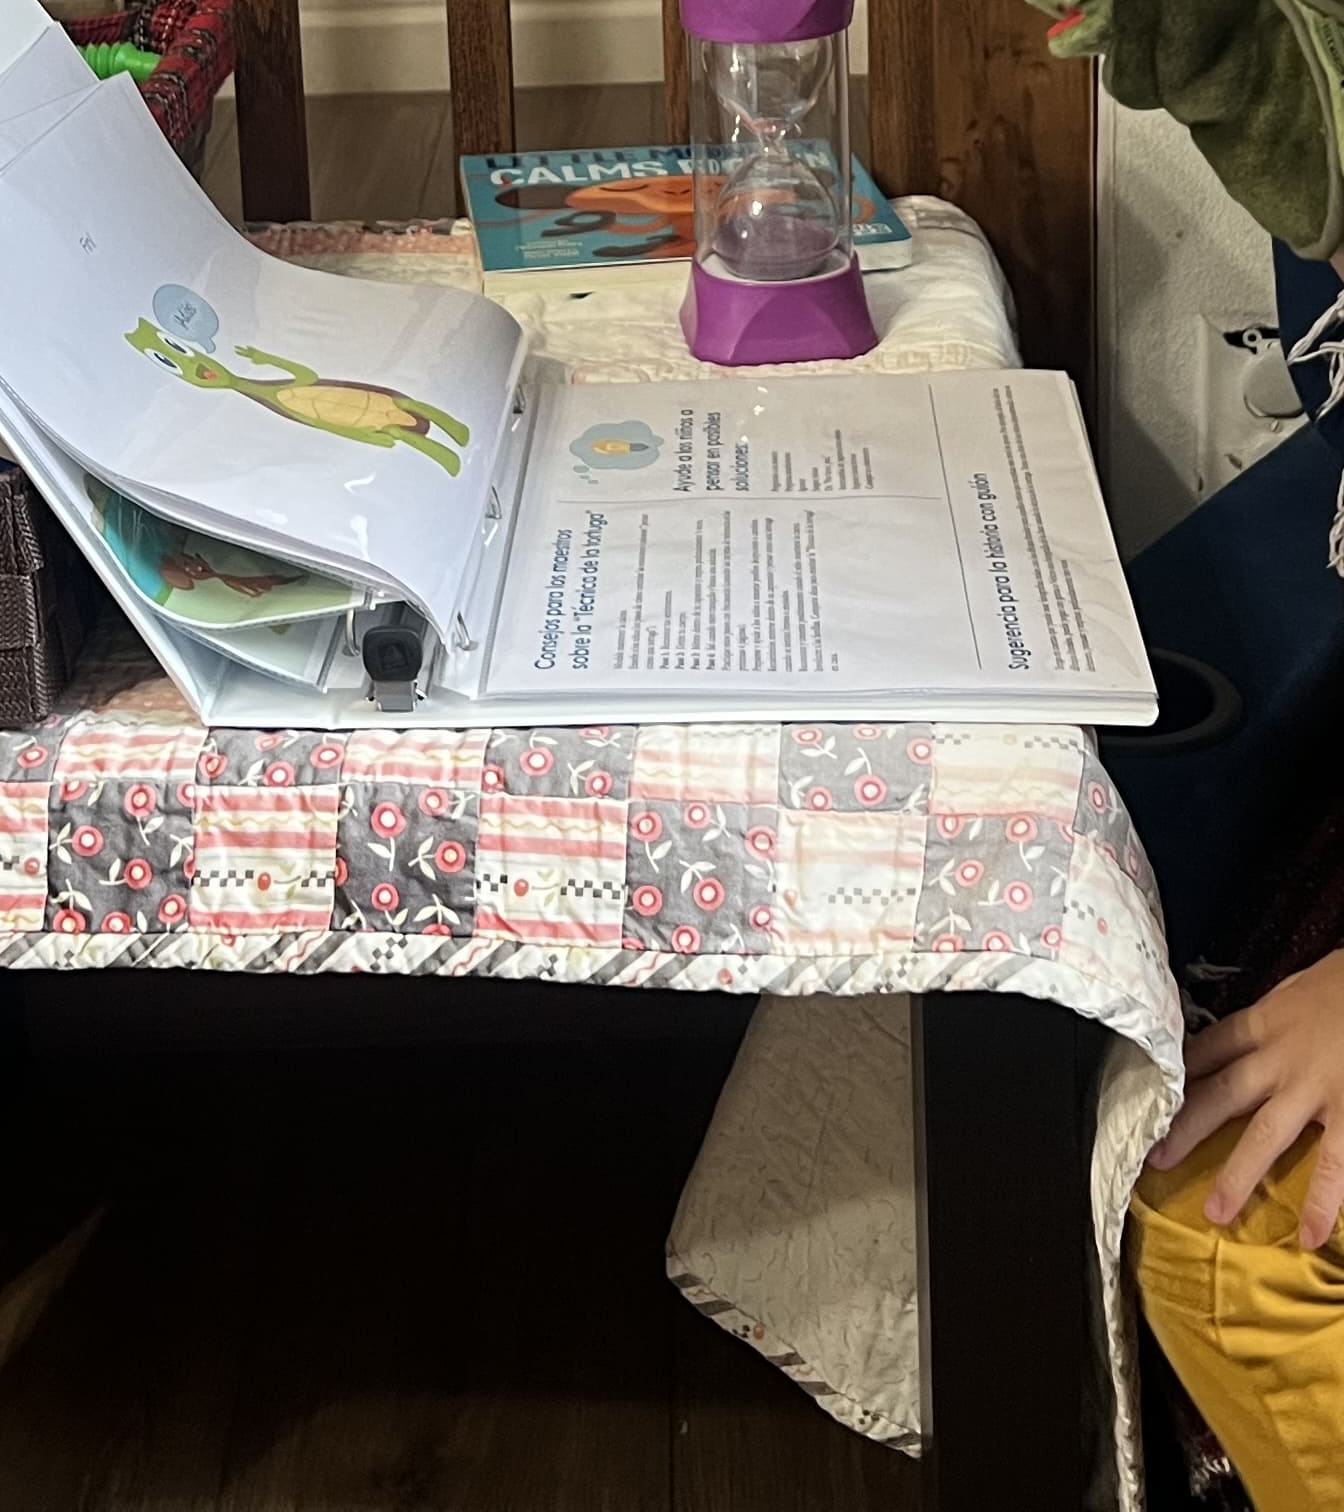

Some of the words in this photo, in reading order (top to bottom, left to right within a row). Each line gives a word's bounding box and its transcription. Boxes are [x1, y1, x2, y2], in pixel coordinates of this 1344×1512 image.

[490, 160, 669, 186] CALMS
[674, 417, 693, 440] niños
[704, 411, 723, 446] posibles
[674, 441, 692, 454] los
[708, 447, 722, 459] en
[672, 463, 699, 492] Ayude
[706, 460, 727, 491] pensar
[967, 472, 998, 501] guión
[980, 502, 997, 521] con
[551, 529, 573, 572] maestros
[579, 548, 601, 558] la
[981, 524, 1005, 559] historia
[577, 561, 599, 574] de
[987, 562, 1008, 573] la
[544, 574, 566, 589] los
[993, 576, 1019, 603] para
[545, 591, 567, 616] para
[570, 624, 593, 635] la
[997, 605, 1032, 671] Sugerencia
[533, 619, 565, 670] Consejos
[568, 638, 592, 670] sobre
